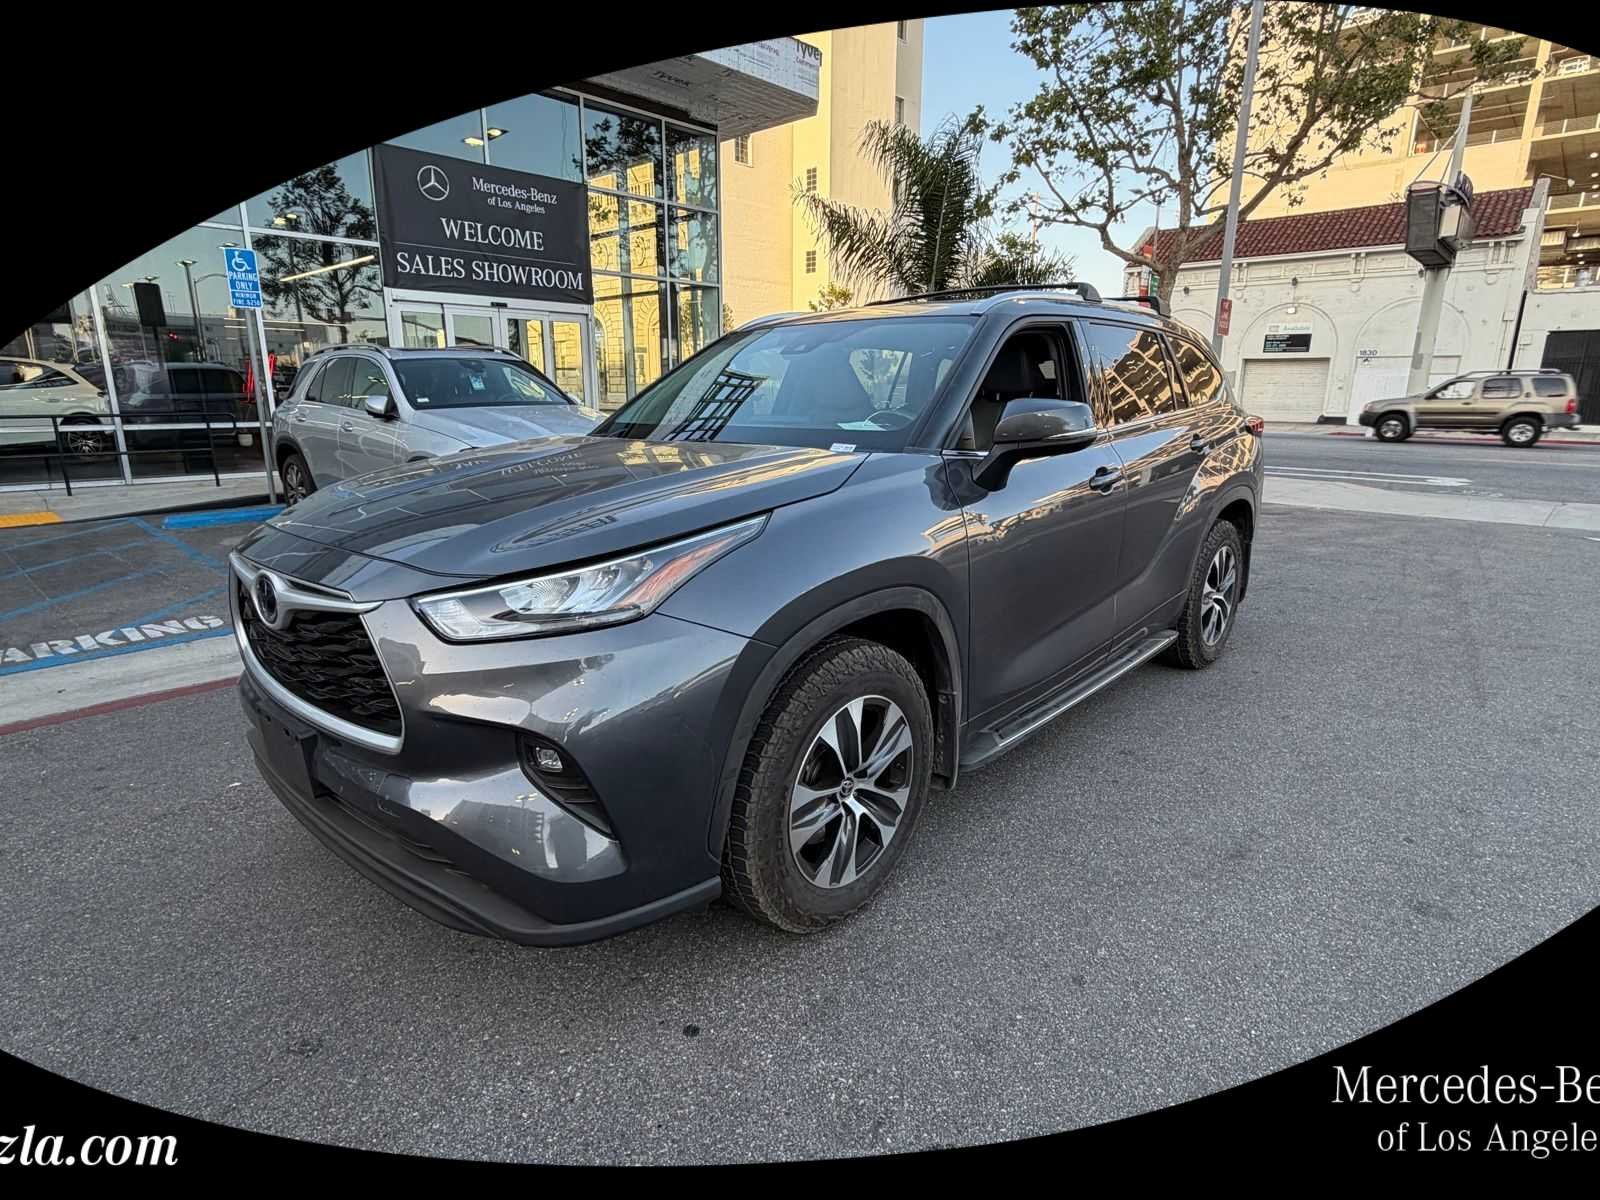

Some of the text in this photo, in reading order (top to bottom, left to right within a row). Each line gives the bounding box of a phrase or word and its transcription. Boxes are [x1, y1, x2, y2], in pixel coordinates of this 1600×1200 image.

[472, 176, 558, 205] Mercedes-Benz
[488, 197, 545, 214] of Los Angeles
[440, 217, 544, 251] WELCOME
[229, 271, 258, 281] PARKING
[396, 252, 584, 290] SALES SHOWROOM
[235, 281, 253, 290] ONLY
